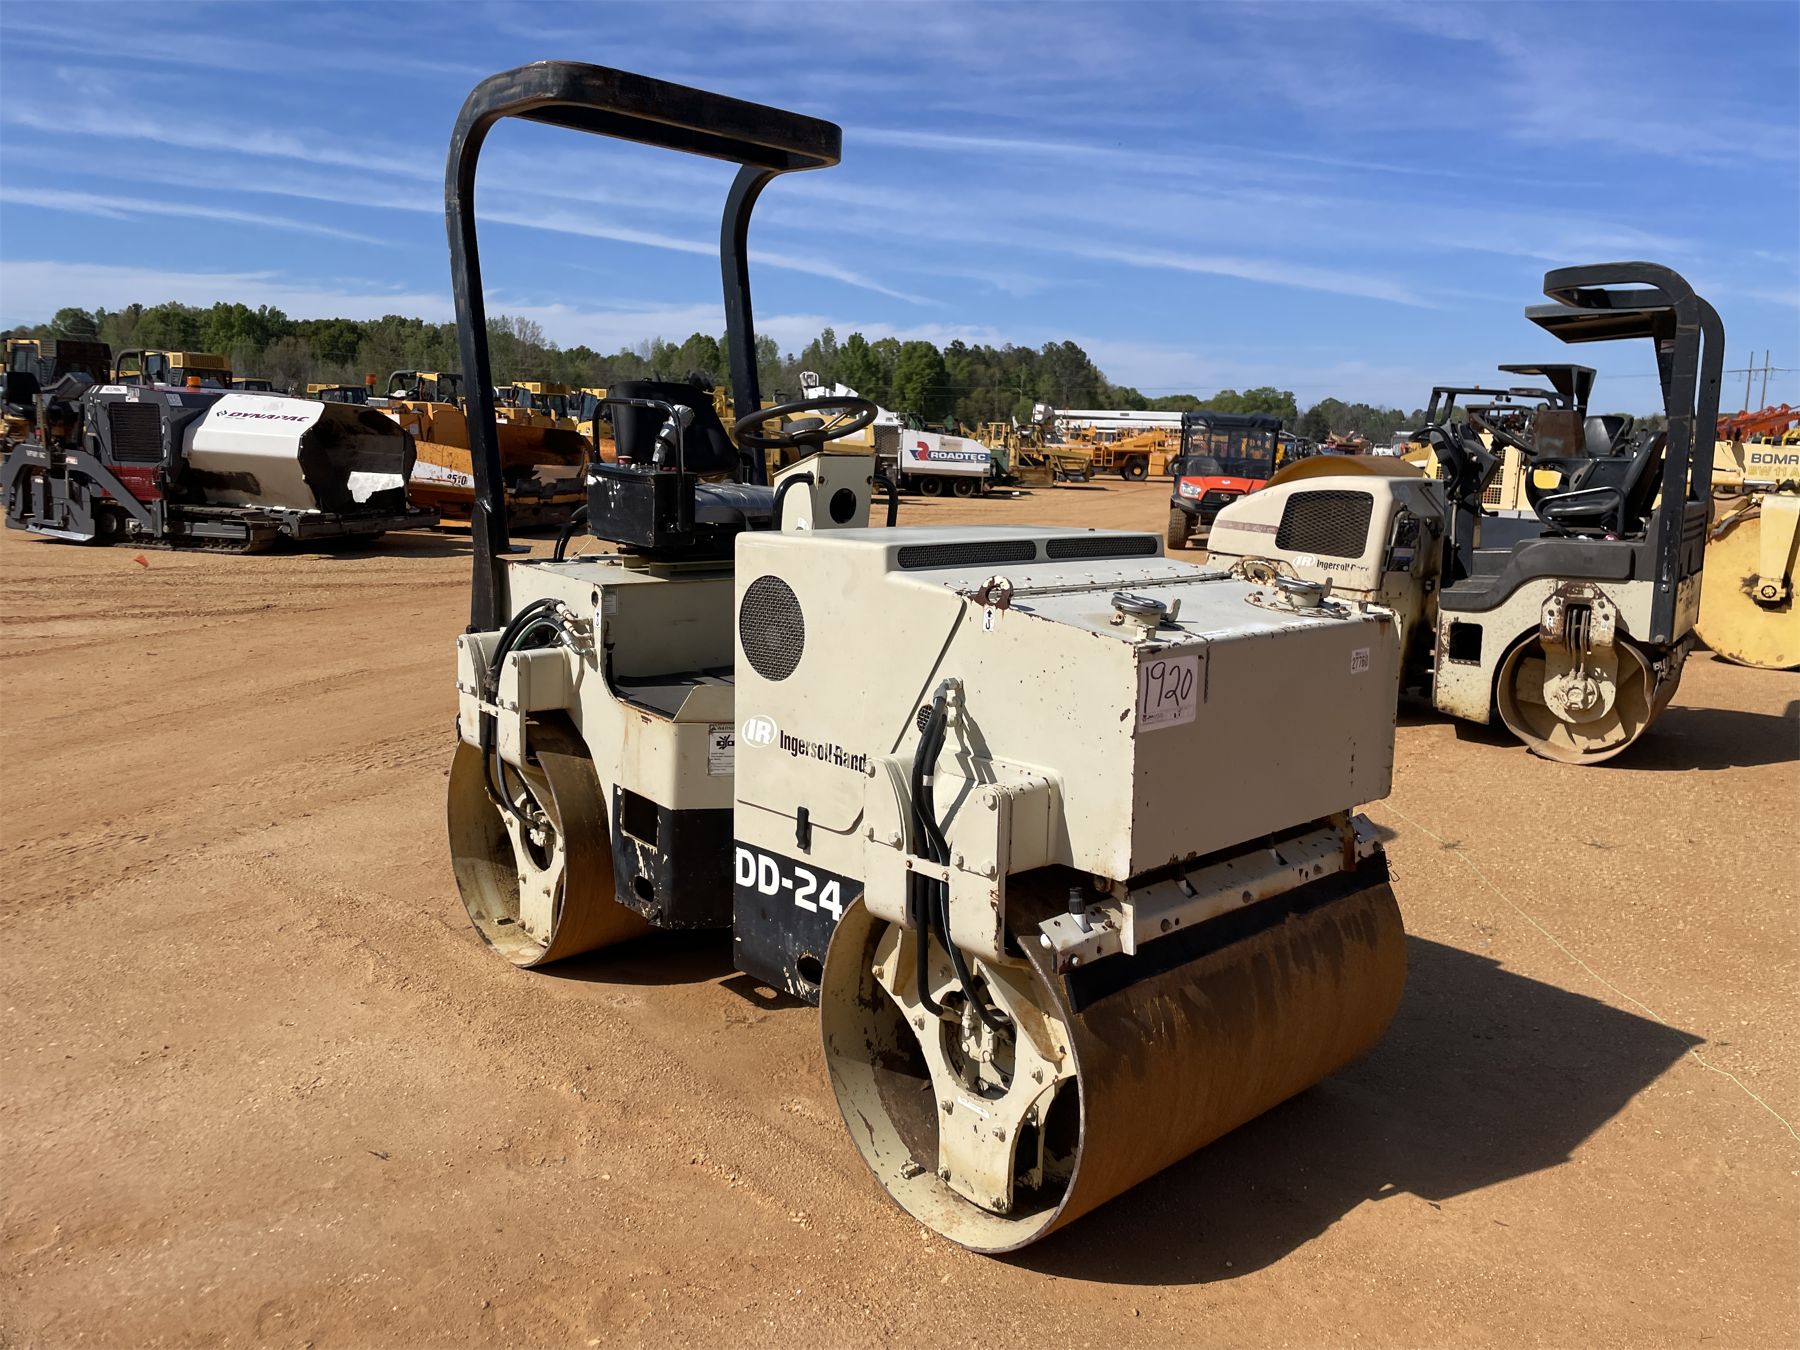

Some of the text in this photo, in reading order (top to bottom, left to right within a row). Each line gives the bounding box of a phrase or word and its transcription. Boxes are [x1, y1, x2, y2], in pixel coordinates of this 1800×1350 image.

[228, 411, 310, 422] DYNAPAC
[930, 451, 986, 460] ROADTEC
[1143, 661, 1193, 714] 1920
[745, 717, 773, 746] IR
[735, 846, 843, 922] DD-24
